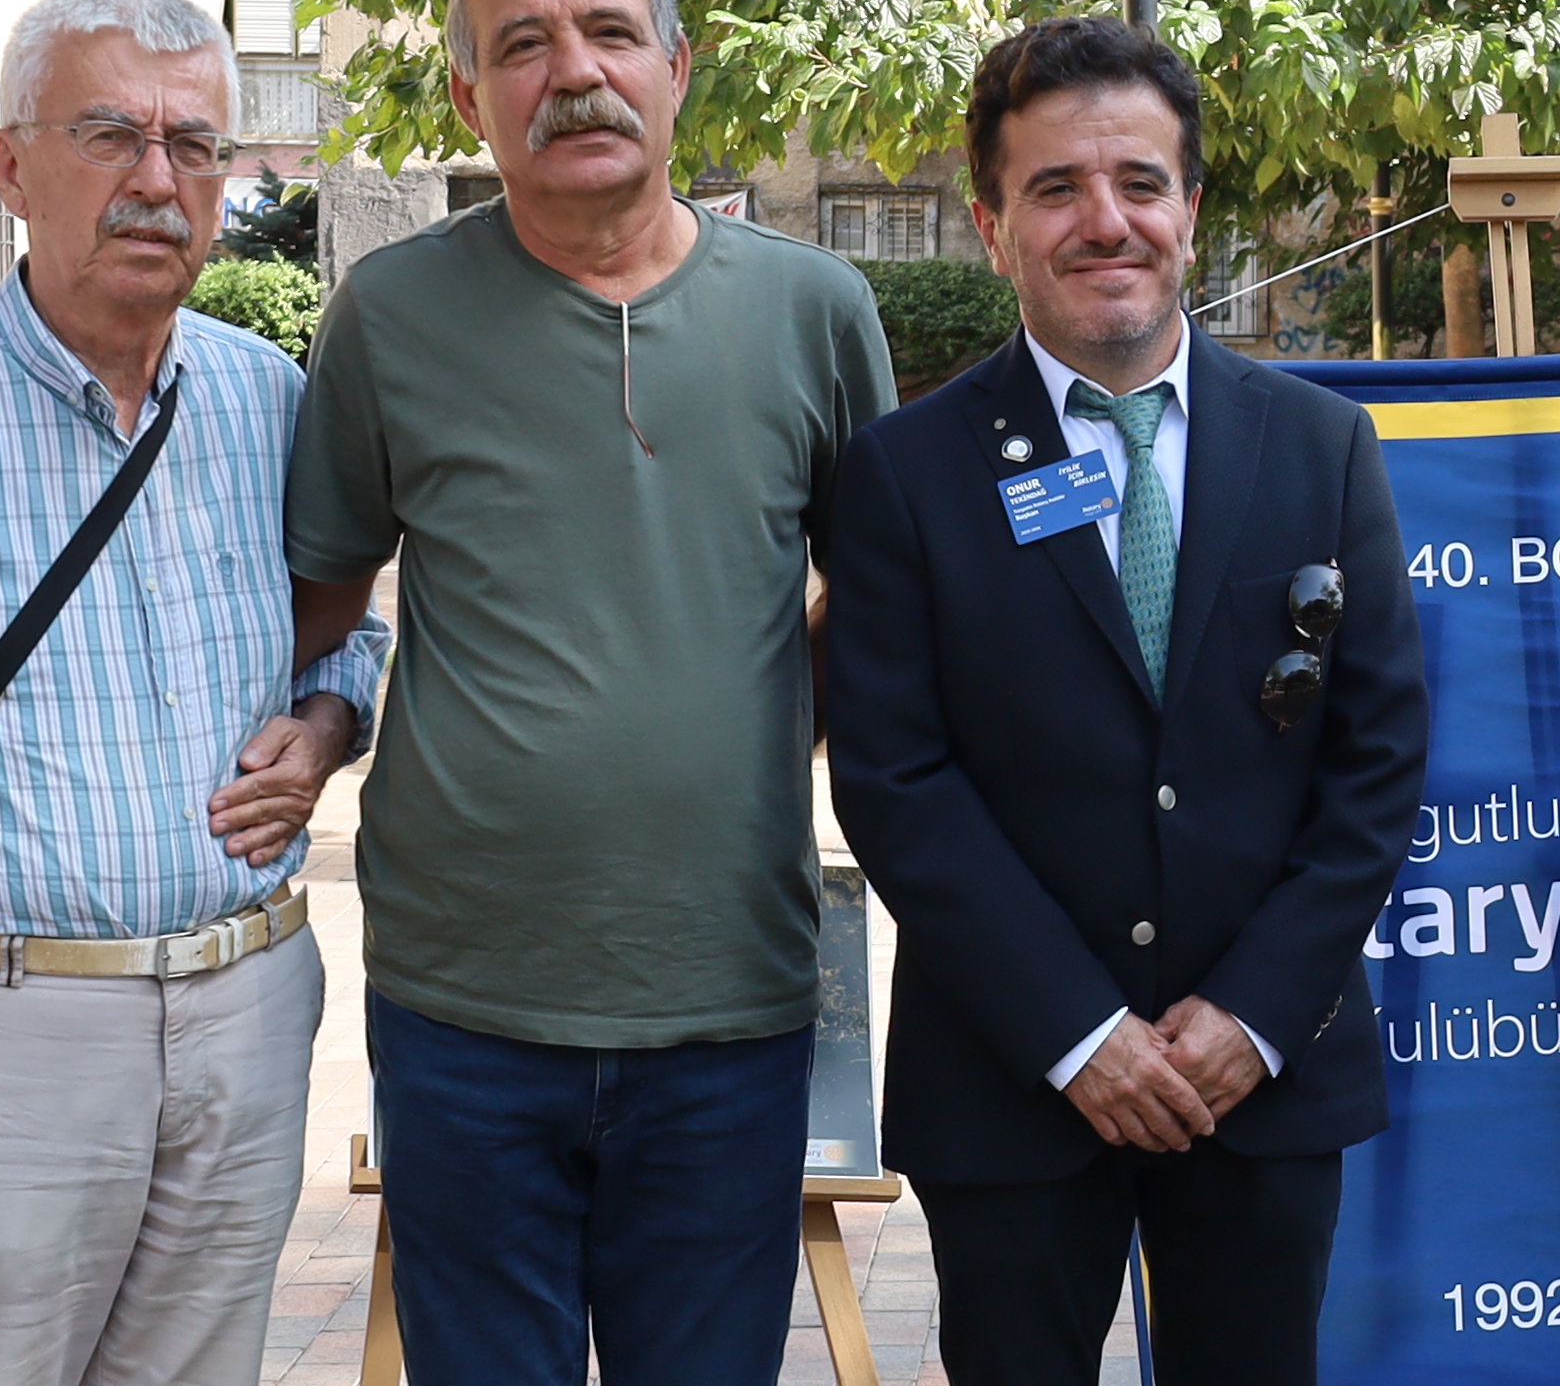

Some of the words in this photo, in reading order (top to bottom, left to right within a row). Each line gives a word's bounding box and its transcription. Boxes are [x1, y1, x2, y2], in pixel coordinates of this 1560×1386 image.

[1006, 478, 1041, 496] ONUR
[1406, 541, 1489, 589] 40.
[1407, 784, 1560, 863] gutlu
